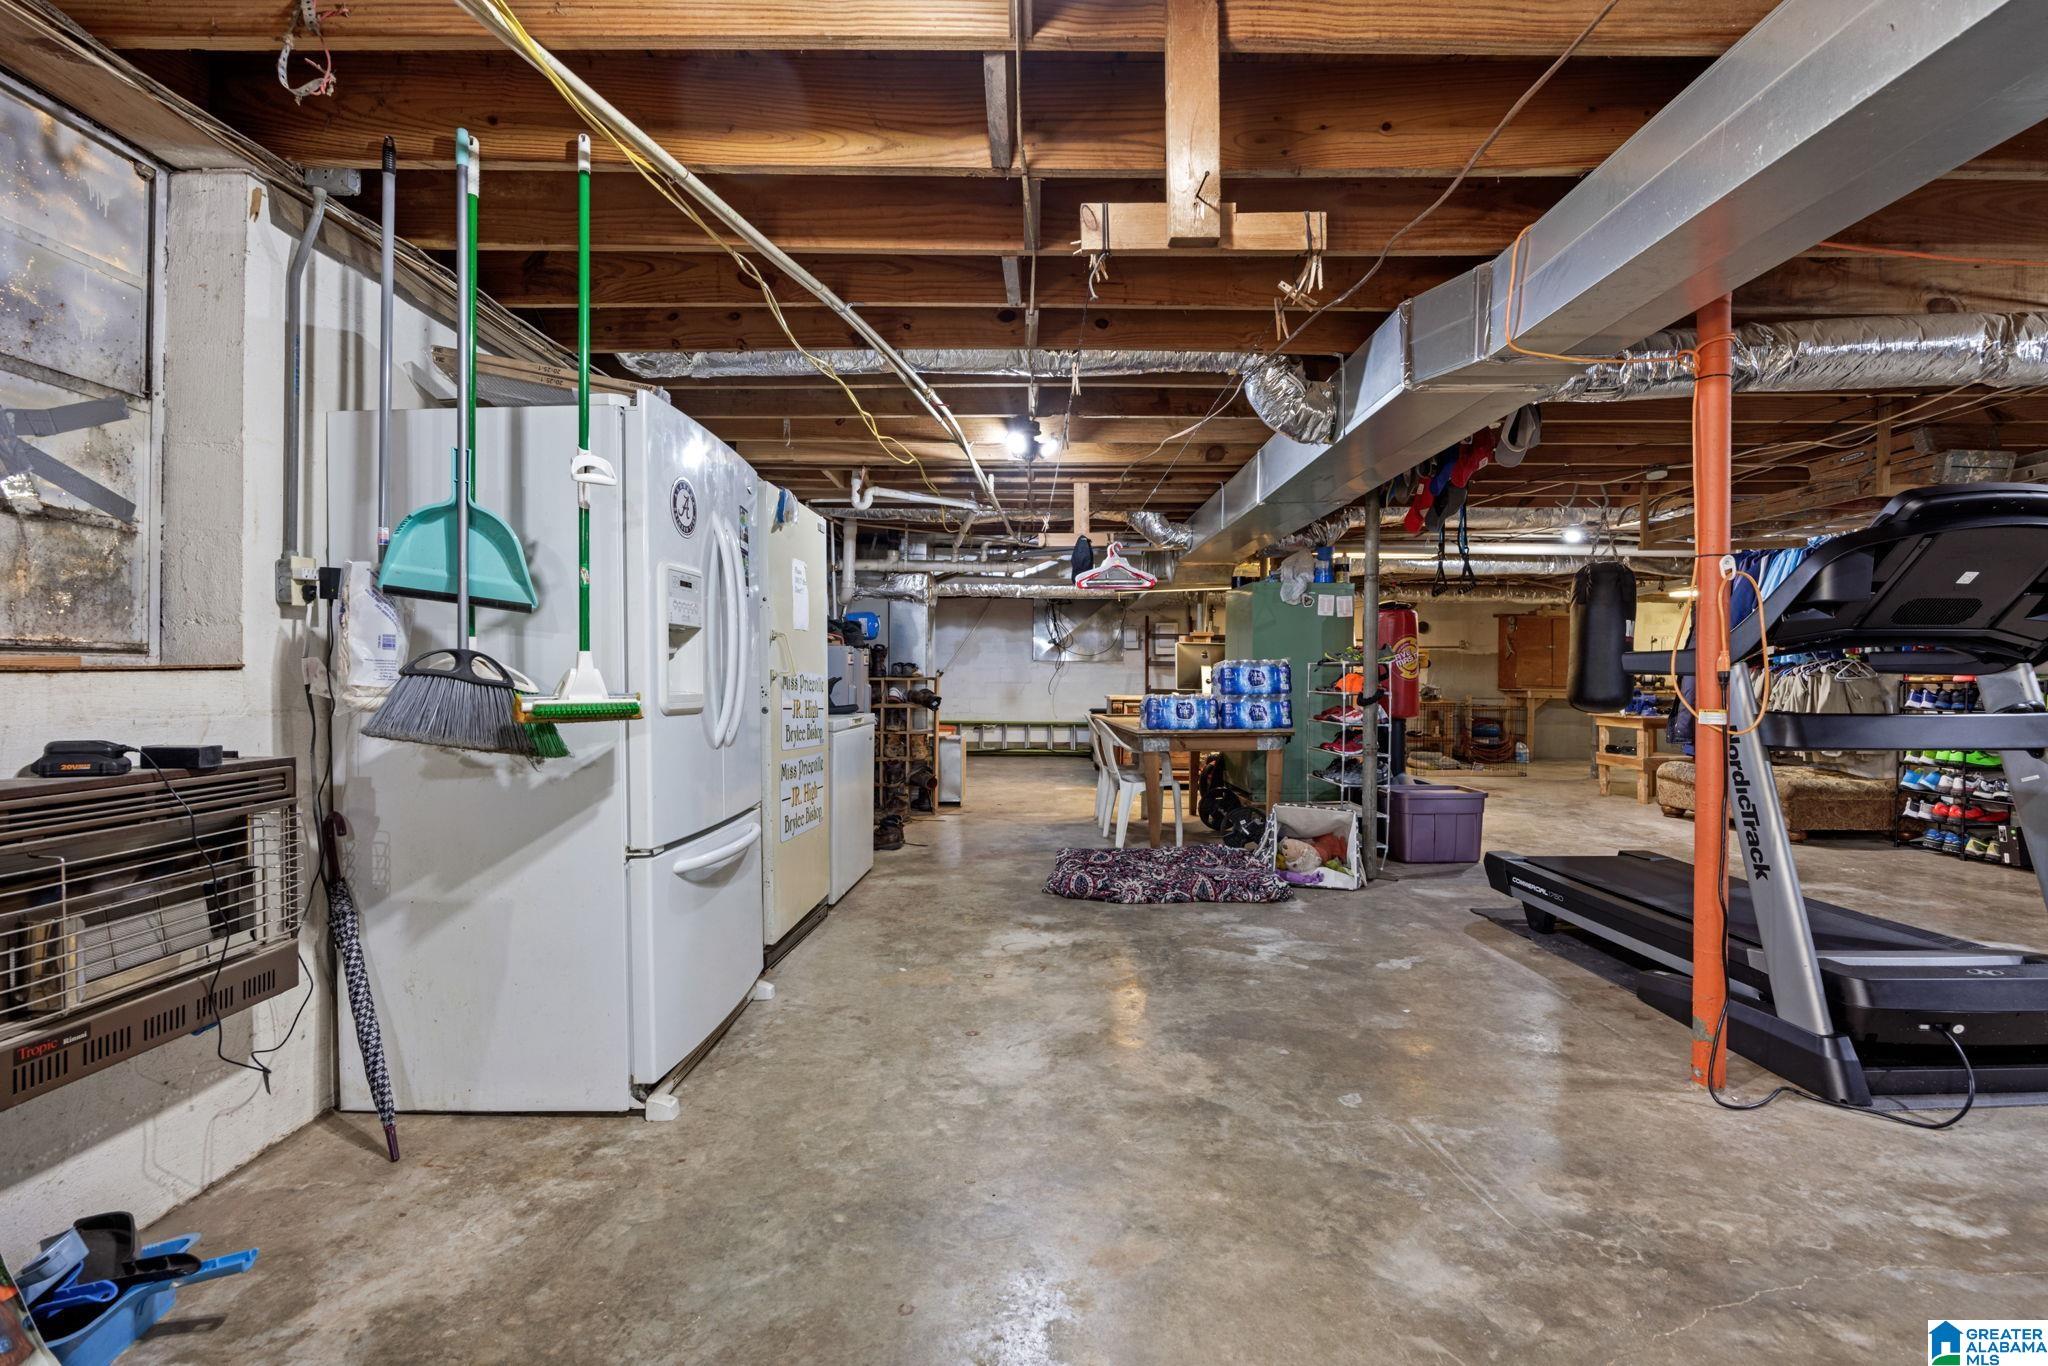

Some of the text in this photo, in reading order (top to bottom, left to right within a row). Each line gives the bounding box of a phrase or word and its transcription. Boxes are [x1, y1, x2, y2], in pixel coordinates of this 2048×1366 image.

[782, 675, 798, 691] Miss
[805, 699, 819, 724] High
[806, 723, 824, 740] Bishop
[780, 763, 798, 781] Miss
[803, 781, 818, 805] High
[805, 804, 823, 824] Bishop
[18, 1040, 58, 1060] Tropic
